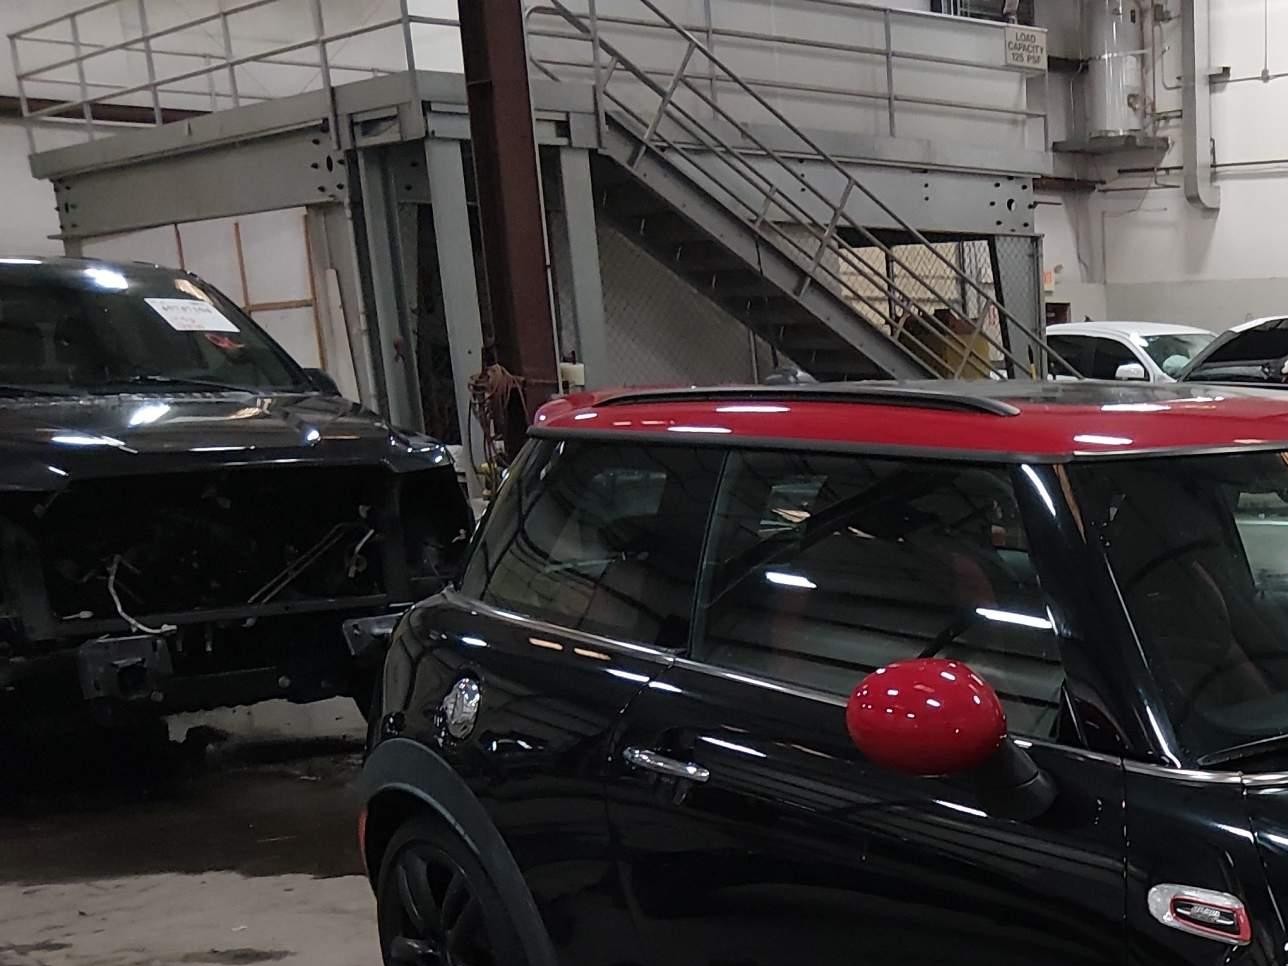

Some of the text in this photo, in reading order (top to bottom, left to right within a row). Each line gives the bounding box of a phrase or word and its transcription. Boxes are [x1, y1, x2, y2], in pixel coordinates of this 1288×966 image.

[1015, 32, 1036, 43] LOAD
[1008, 41, 1044, 54] CAPACITY
[1012, 52, 1041, 64] 125 PSF
